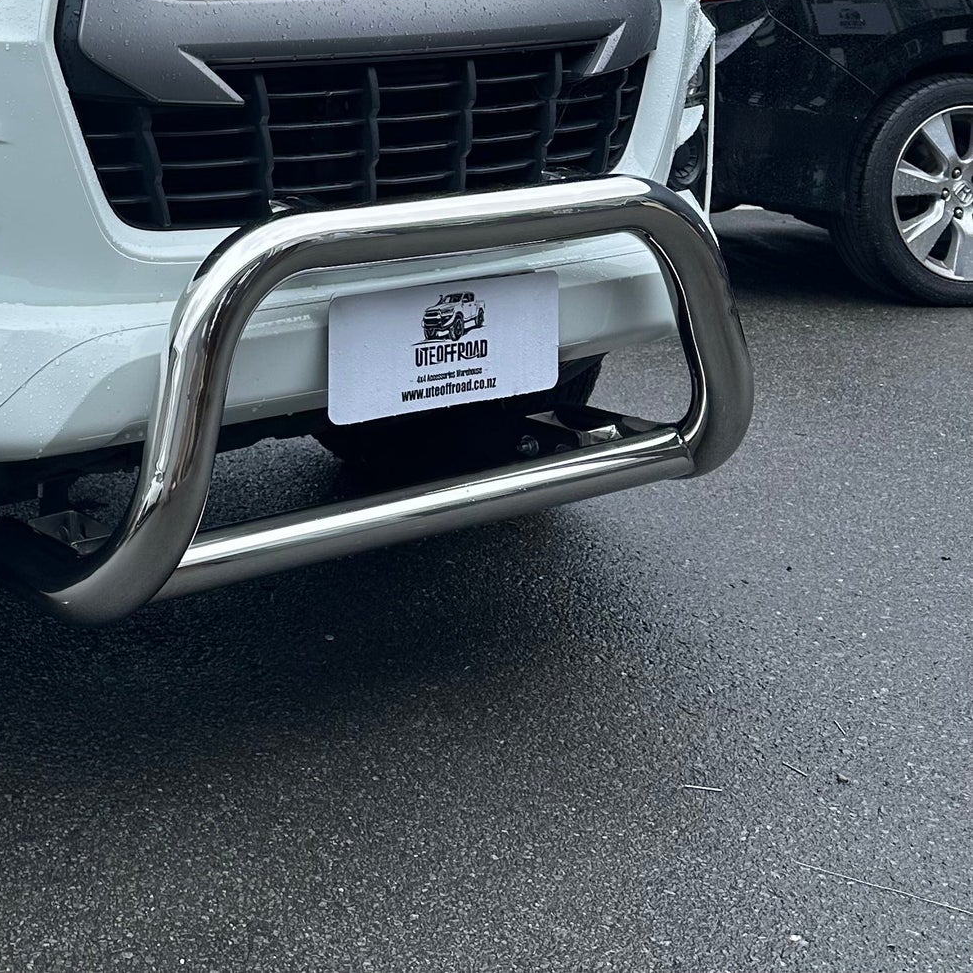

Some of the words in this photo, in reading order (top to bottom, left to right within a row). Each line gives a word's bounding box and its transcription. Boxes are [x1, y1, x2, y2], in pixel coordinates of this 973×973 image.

[427, 371, 456, 382] Accessories
[456, 367, 483, 378] Warehouse
[401, 377, 497, 402] www.uteoffroad.co.nz
